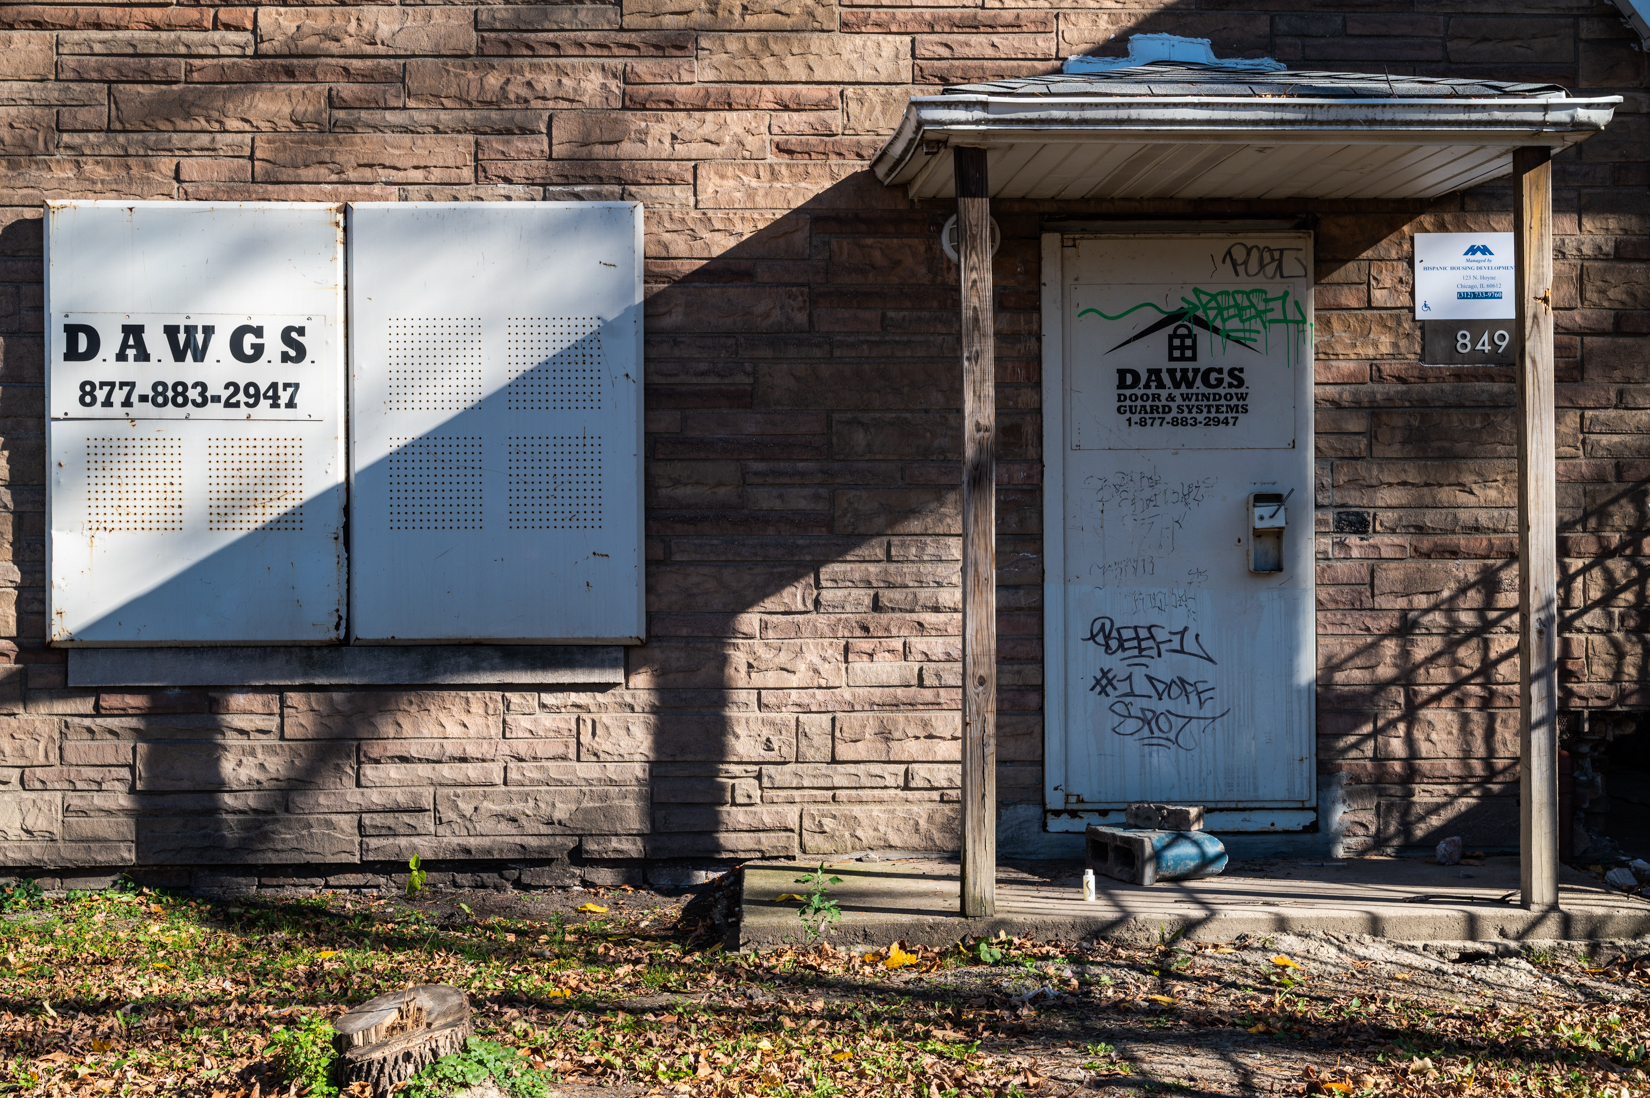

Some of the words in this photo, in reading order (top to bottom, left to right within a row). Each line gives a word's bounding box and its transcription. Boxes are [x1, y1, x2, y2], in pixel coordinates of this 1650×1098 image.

[63, 323, 315, 364] D.A.W.G.S.
[1456, 329, 1510, 354] 849
[1116, 367, 1250, 390] D.A.W.G.S.
[78, 380, 300, 409] 877-883-2947
[1116, 392, 1162, 403] DOOR
[1165, 392, 1177, 402] &
[1180, 392, 1249, 402] WINDOW
[1116, 404, 1173, 415] GUARD
[1177, 403, 1249, 415] SYSTEMS
[1126, 416, 1239, 427] 1-877-883-2947
